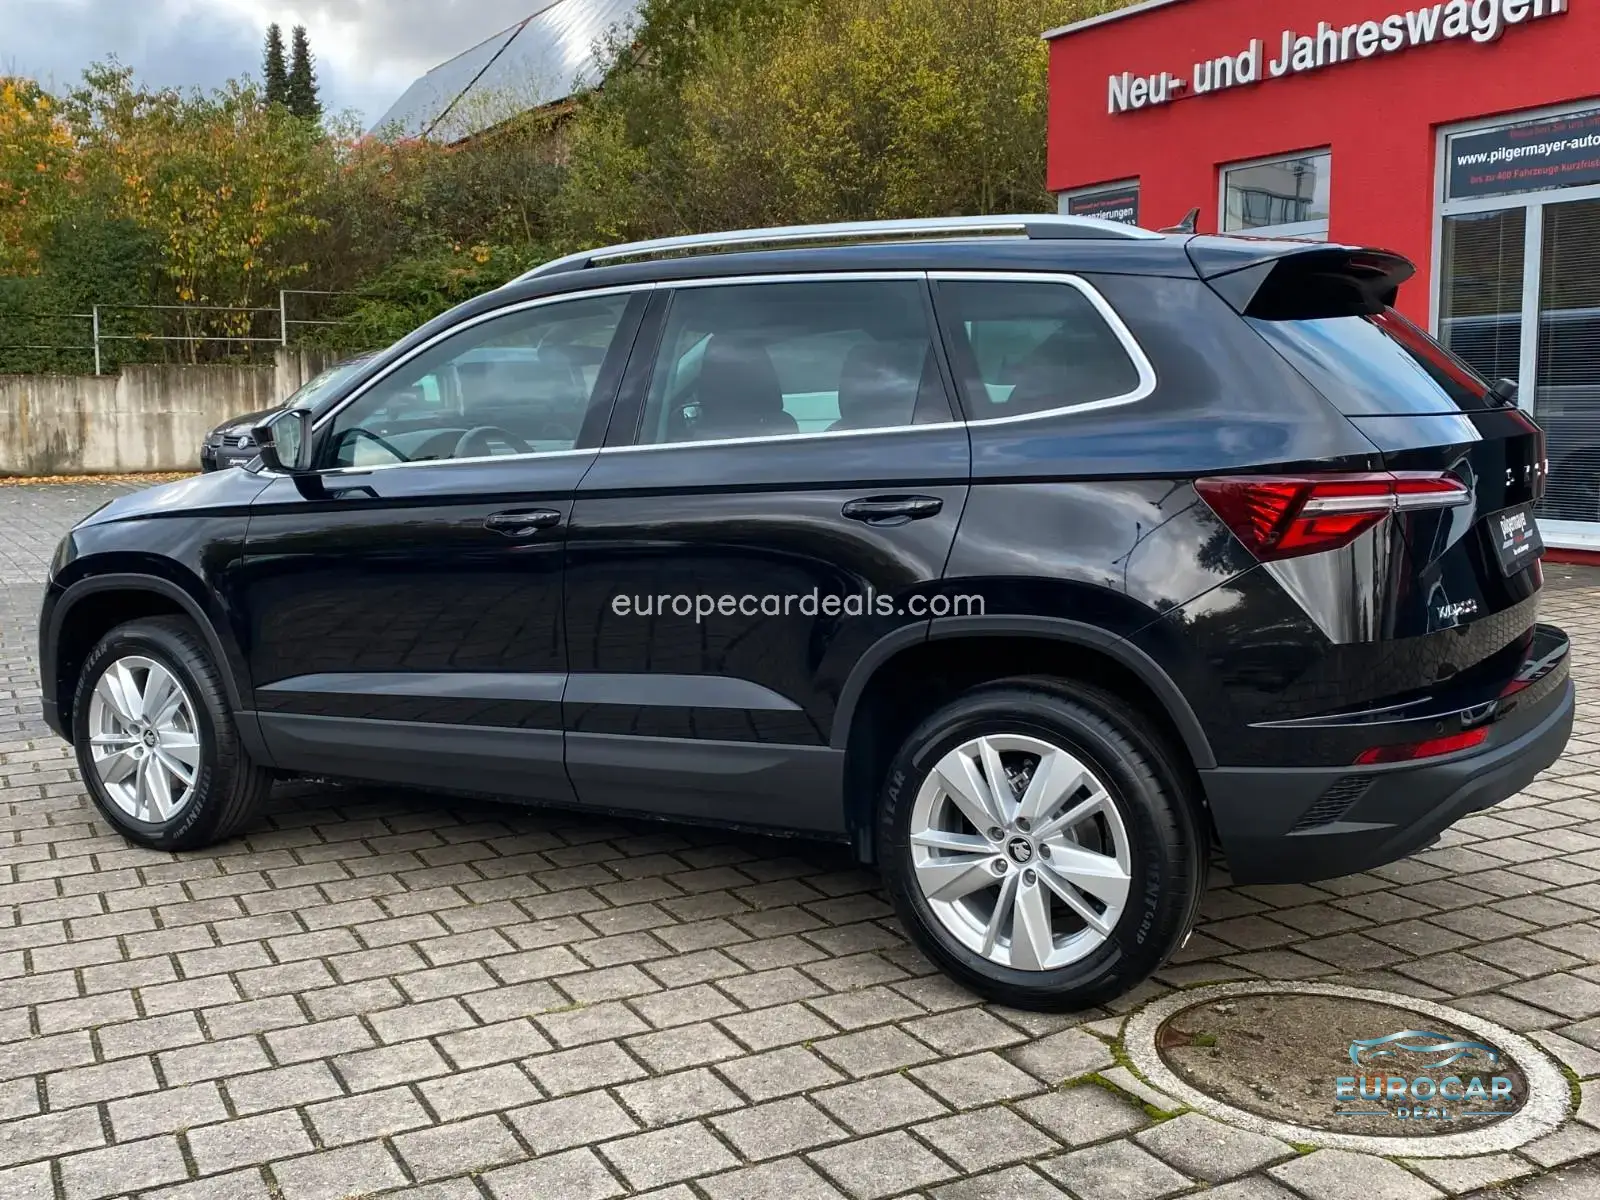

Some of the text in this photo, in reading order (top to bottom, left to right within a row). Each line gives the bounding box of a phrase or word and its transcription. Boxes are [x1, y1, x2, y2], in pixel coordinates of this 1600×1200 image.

[1108, 72, 1181, 114] Neu-
[1194, 39, 1259, 93] und
[1514, 165, 1559, 178] Fahrzeuge
[1076, 207, 1134, 220] anzierungen
